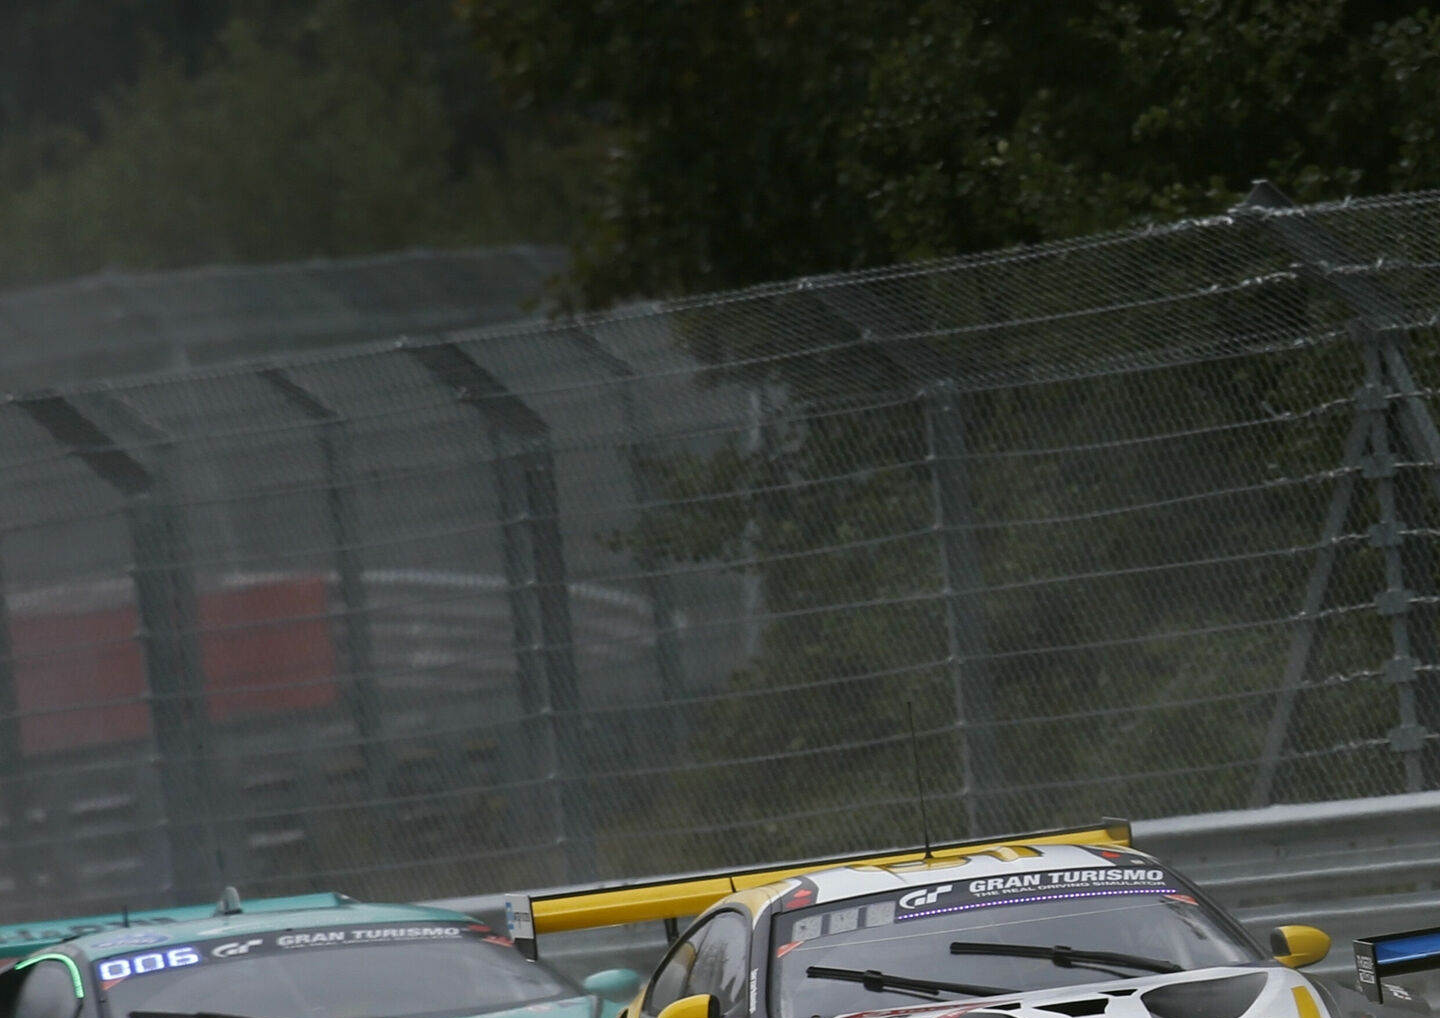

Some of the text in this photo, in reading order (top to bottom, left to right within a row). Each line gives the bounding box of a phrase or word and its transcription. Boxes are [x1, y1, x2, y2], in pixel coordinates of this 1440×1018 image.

[969, 873, 1041, 893] GRAN
[1047, 869, 1163, 883] TURISMO
[974, 879, 1166, 898] THE REAL DRIVING SIMULATOR
[276, 931, 345, 948] GRAN
[351, 926, 459, 940] TURISMO
[100, 947, 200, 981] 006
